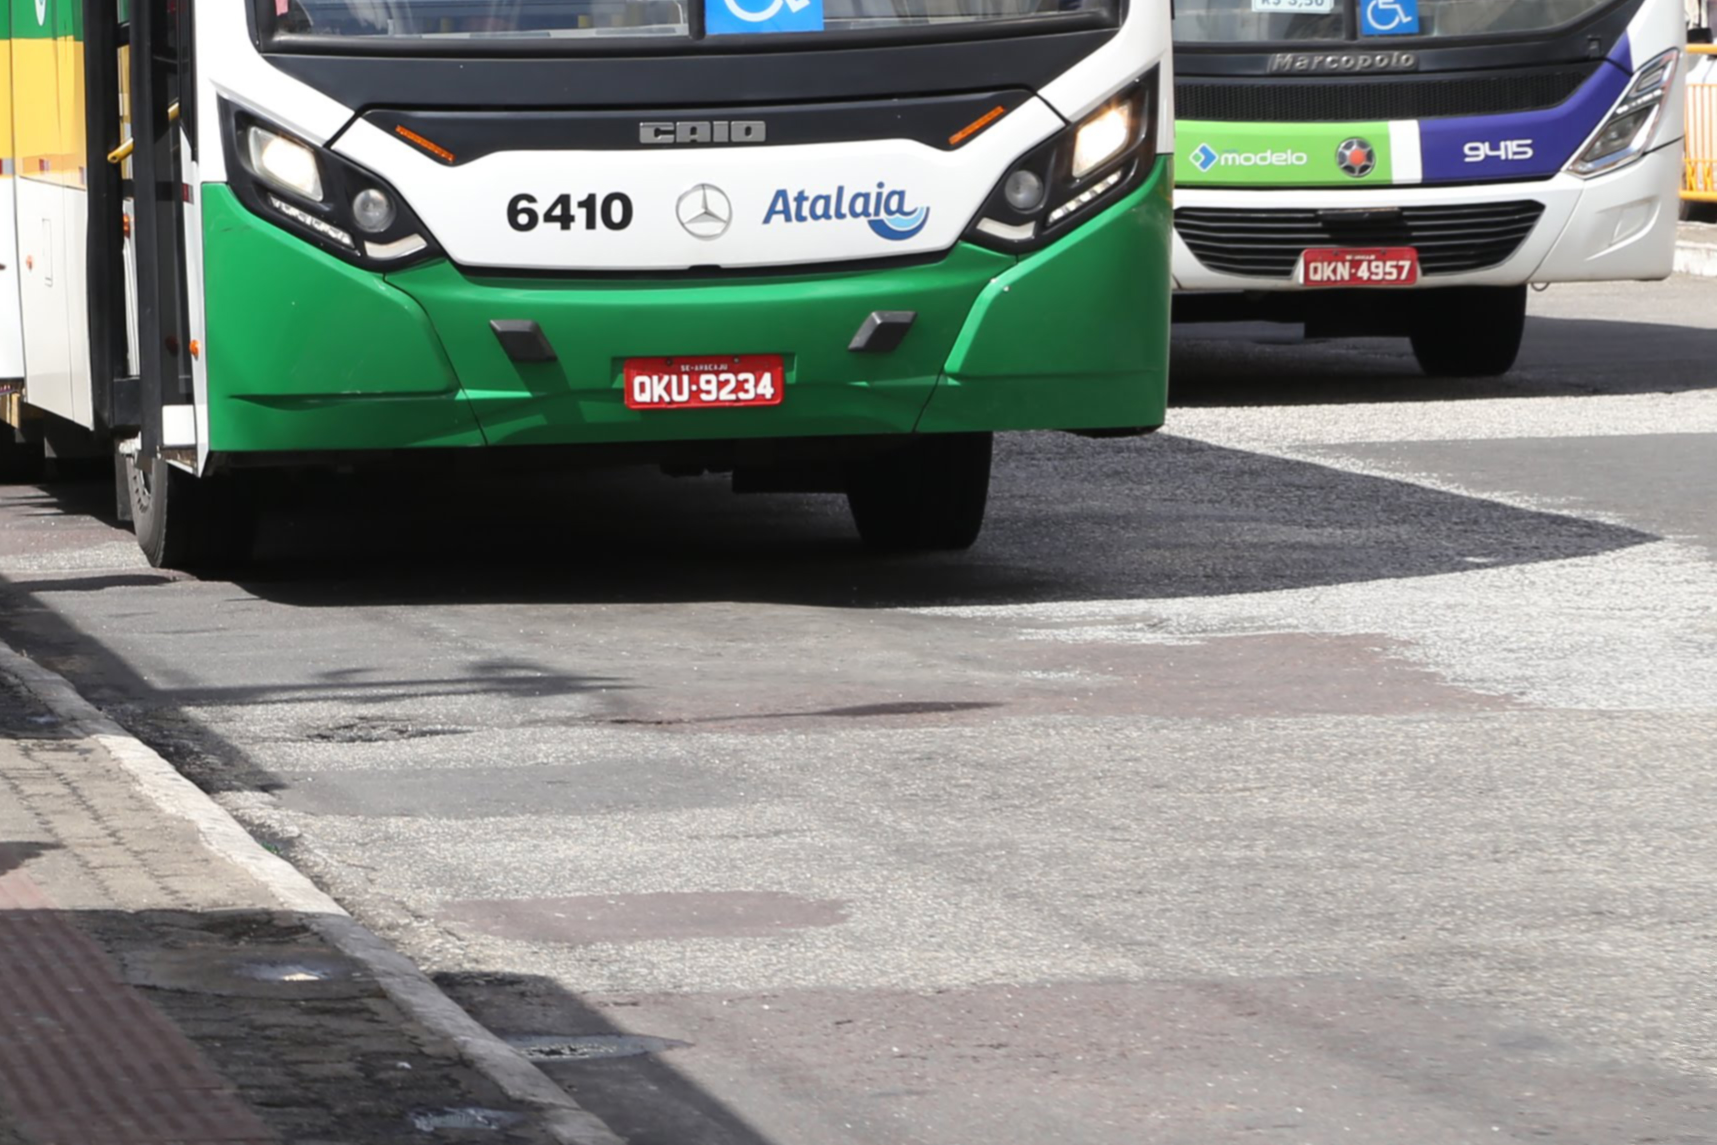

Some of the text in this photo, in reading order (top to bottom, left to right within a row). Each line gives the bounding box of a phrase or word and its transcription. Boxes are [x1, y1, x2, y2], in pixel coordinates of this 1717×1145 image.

[1272, 52, 1416, 72] Marcopolo
[639, 121, 766, 144] CAIO
[1220, 149, 1308, 166] modelo
[1463, 139, 1534, 162] 9415
[506, 191, 634, 233] 6410
[761, 182, 920, 226] Atalaia
